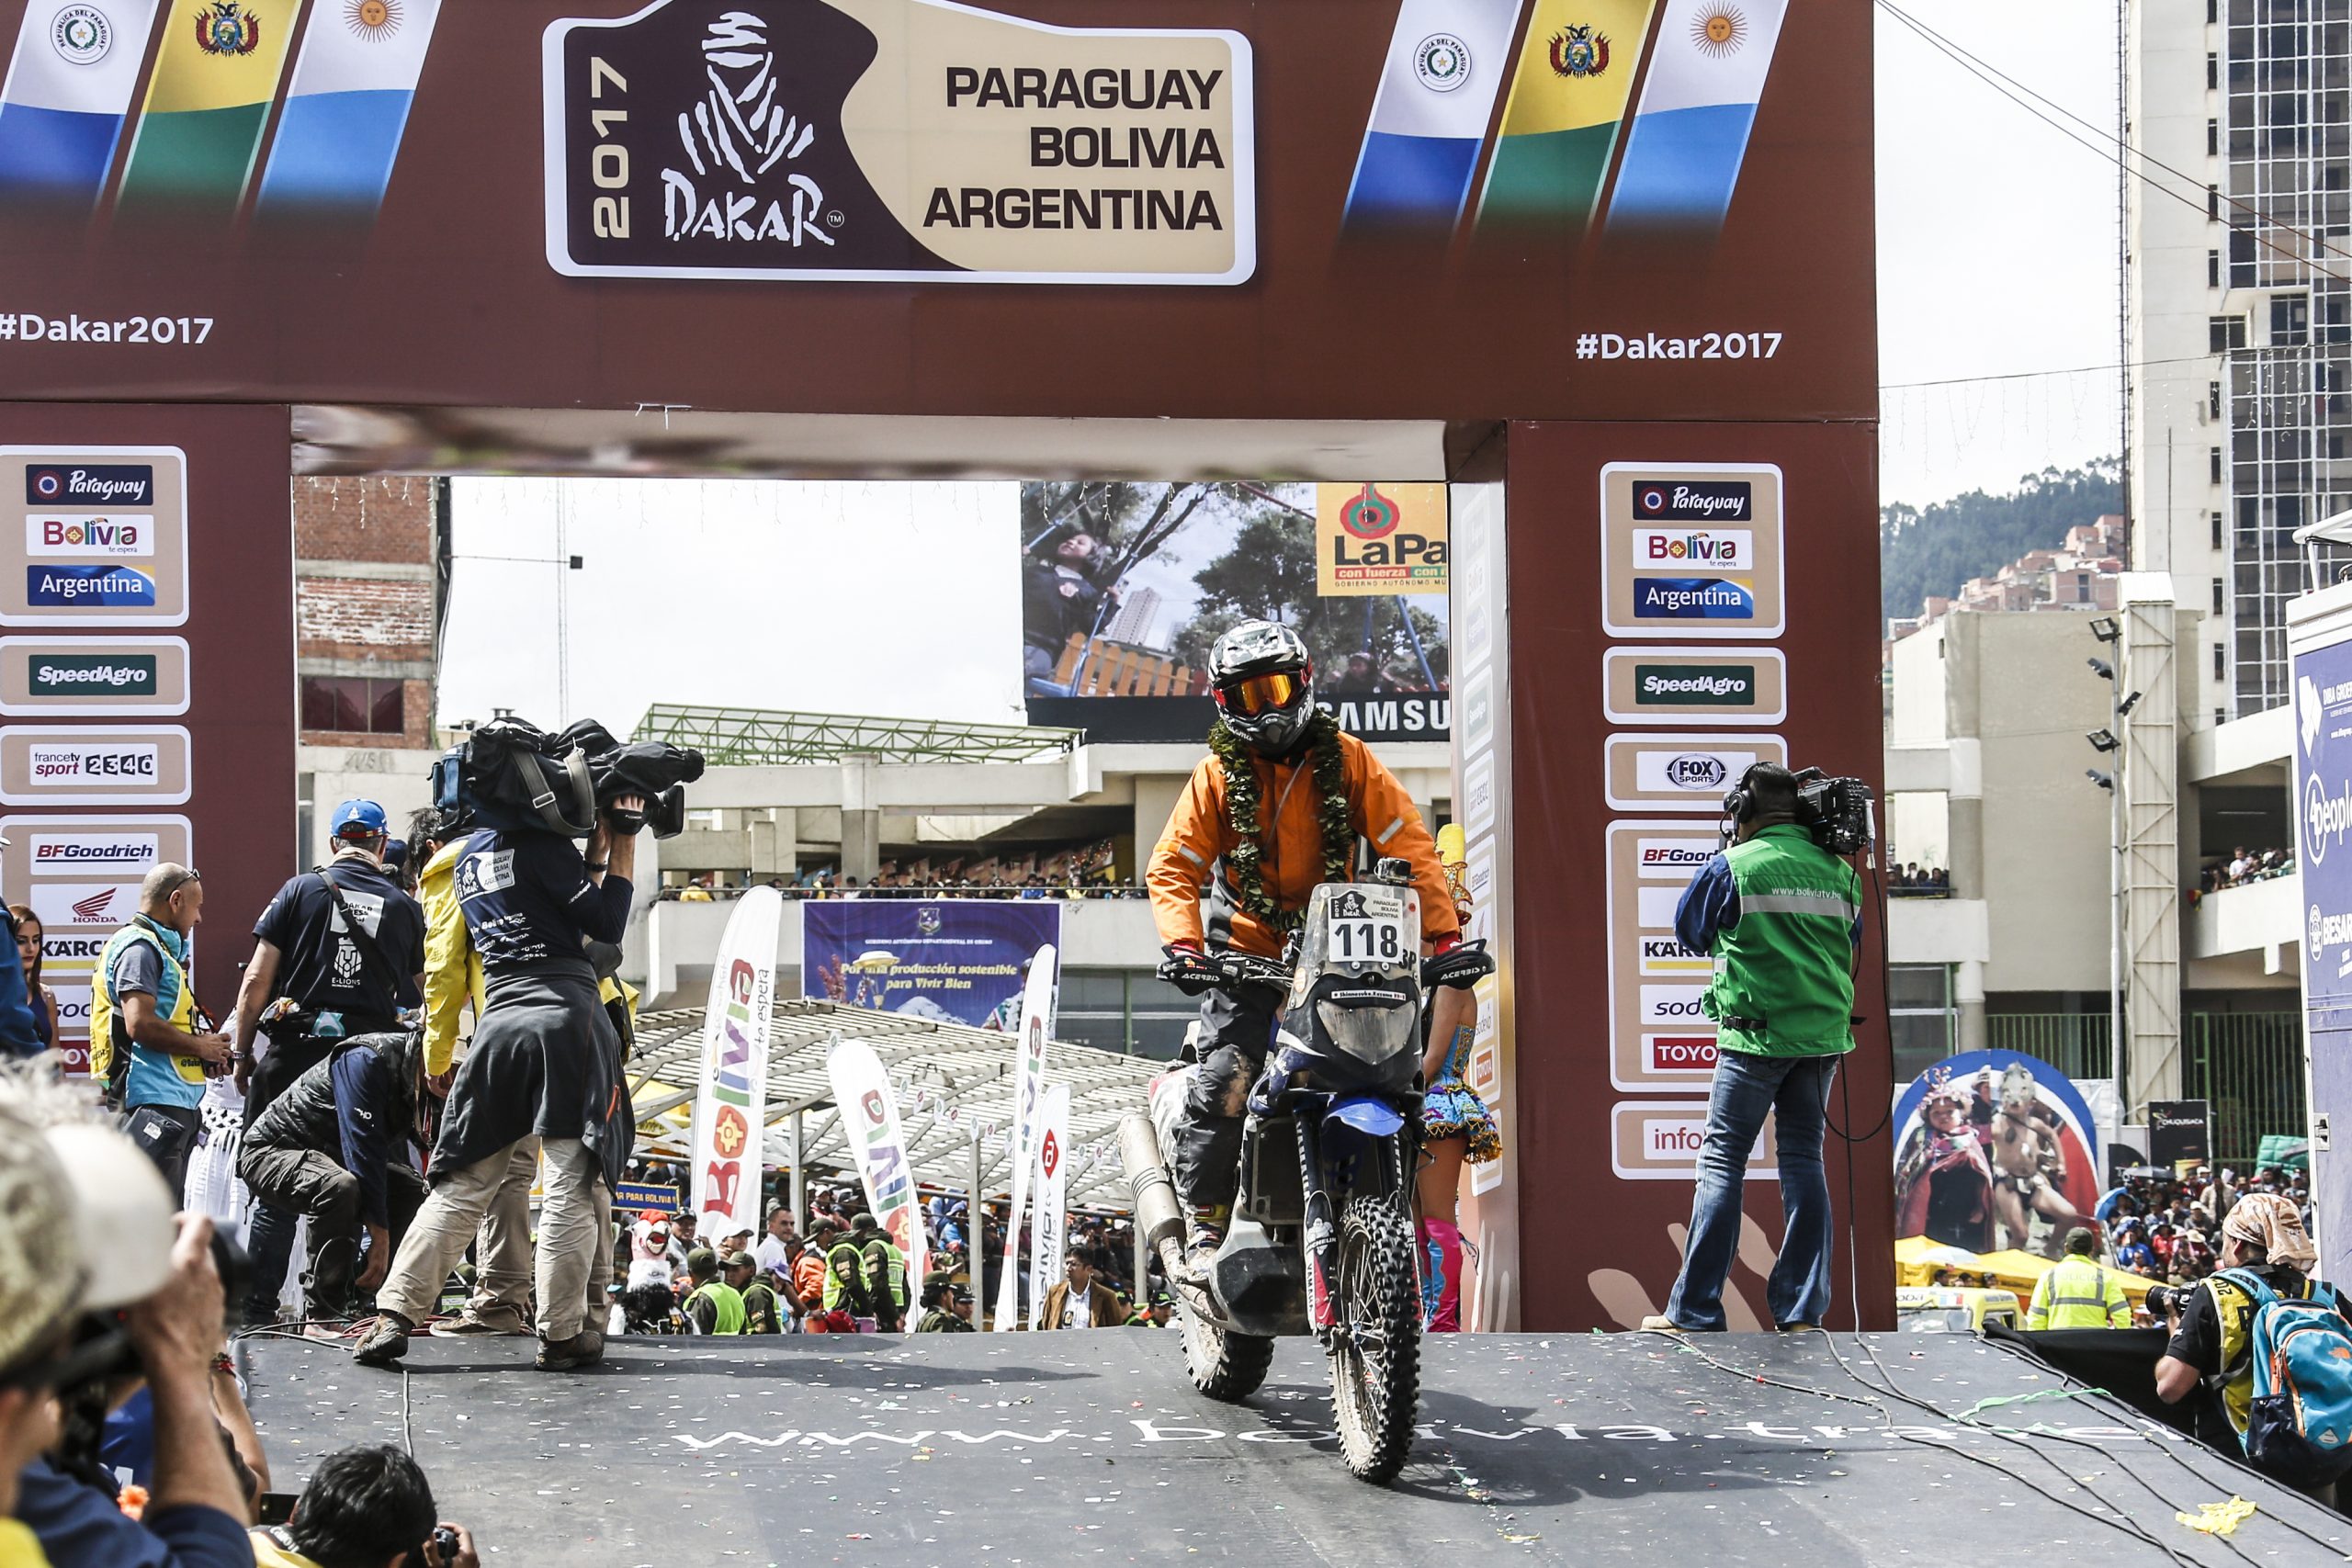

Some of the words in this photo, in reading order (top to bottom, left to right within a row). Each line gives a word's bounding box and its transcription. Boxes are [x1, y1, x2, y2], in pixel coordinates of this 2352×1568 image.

[946, 67, 1223, 110] PARAGUAY
[590, 56, 628, 239] 2017
[1030, 127, 1225, 169] BOLIVIA
[661, 167, 835, 247] DAKAR
[923, 187, 1223, 231] ARGENTINA
[0, 313, 214, 344] #Dakar2017
[1576, 333, 1782, 360] #Dakar2017
[69, 469, 145, 501] Paraguay
[1672, 486, 1745, 516] Paraguay
[44, 519, 137, 545] Bolivia
[1649, 535, 1736, 559] Bolivia
[1339, 569, 1363, 579] con
[1366, 567, 1407, 579] fuerza
[1414, 568, 1438, 577] con
[40, 574, 143, 598] Argentina
[1645, 587, 1741, 610] Argentina
[38, 665, 147, 686] SpeedAgro
[1643, 675, 1746, 696] SpeedAgro
[35, 761, 79, 778] sport
[1679, 761, 1713, 776] FOX
[1679, 775, 1714, 784] SPORTS
[37, 843, 153, 858] BFGoodrich
[1334, 923, 1398, 958] 118
[841, 964, 861, 976] Por
[889, 962, 956, 976] producción
[958, 964, 1018, 976] sostenible
[1182, 973, 1220, 982] ACERBIS
[1440, 964, 1480, 981] ACERBIS
[332, 976, 361, 986] E-LIONS
[887, 979, 912, 991] para
[915, 977, 943, 989] Vivir
[944, 977, 972, 989] Bien
[755, 968, 769, 1022] espera
[645, 1193, 672, 1204] BOLIVIA
